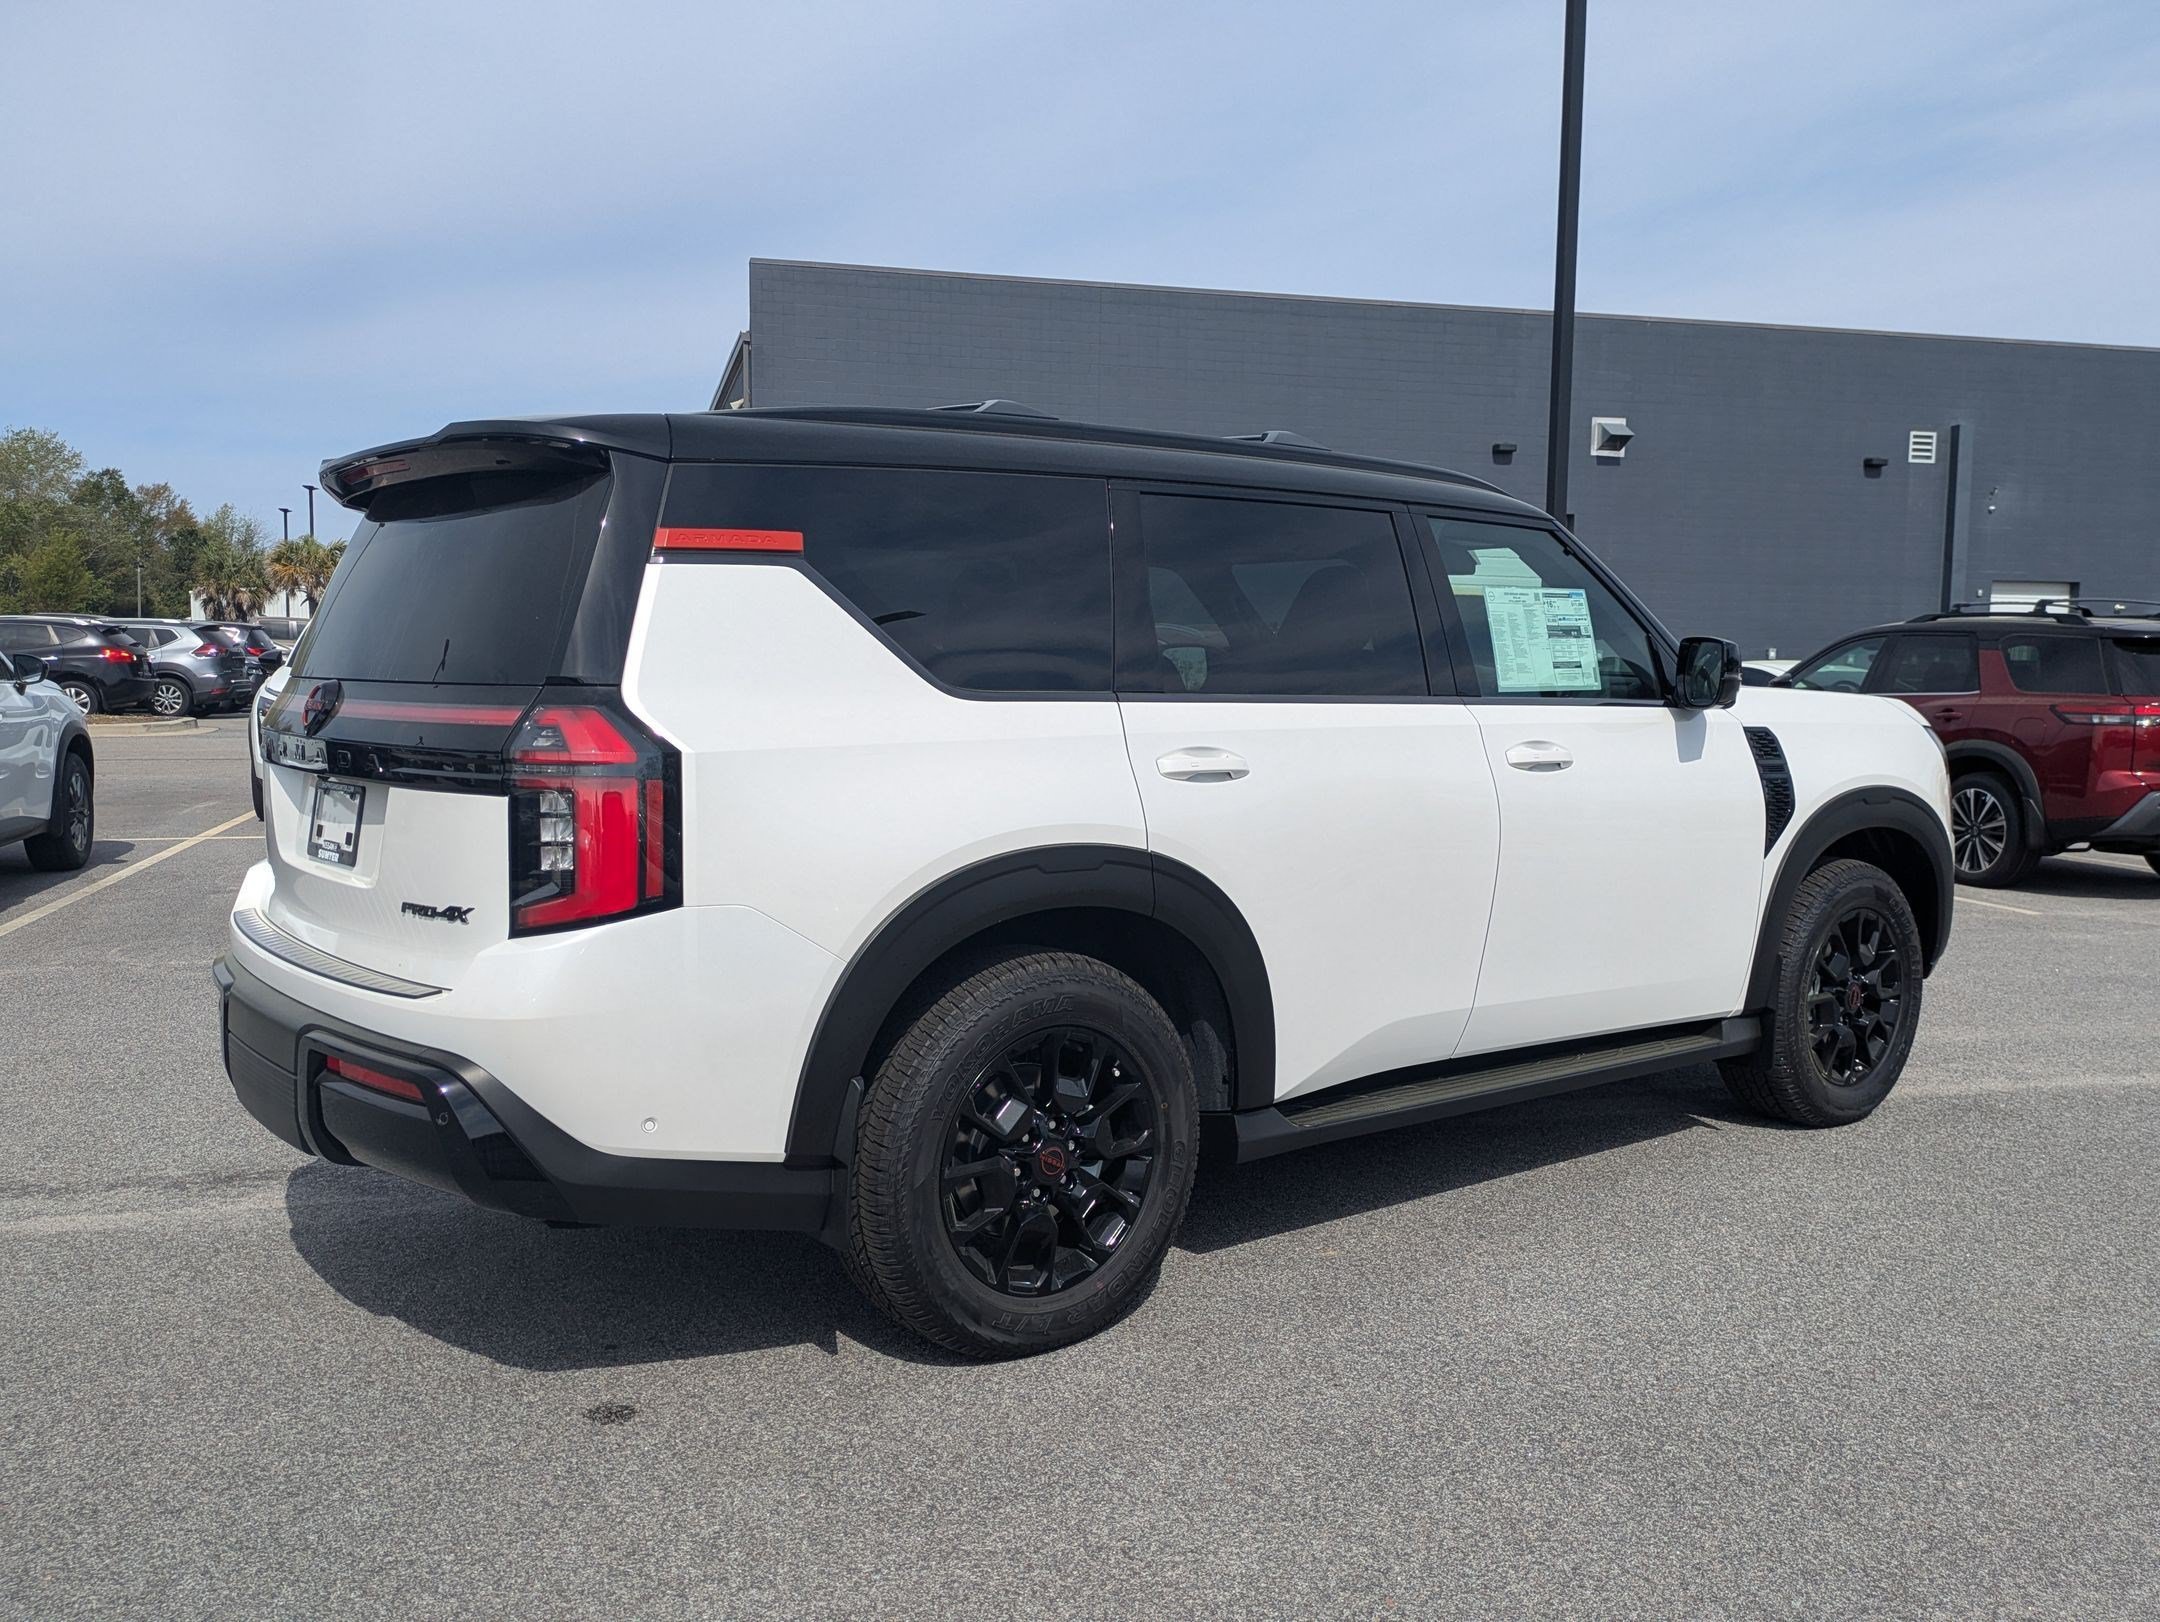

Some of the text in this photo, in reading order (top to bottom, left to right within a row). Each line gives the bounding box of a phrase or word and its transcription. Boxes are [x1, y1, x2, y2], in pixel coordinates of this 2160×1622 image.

[674, 533, 777, 546] ARMADA
[318, 849, 339, 862] SUMTER
[400, 901, 476, 924] PRO-4X
